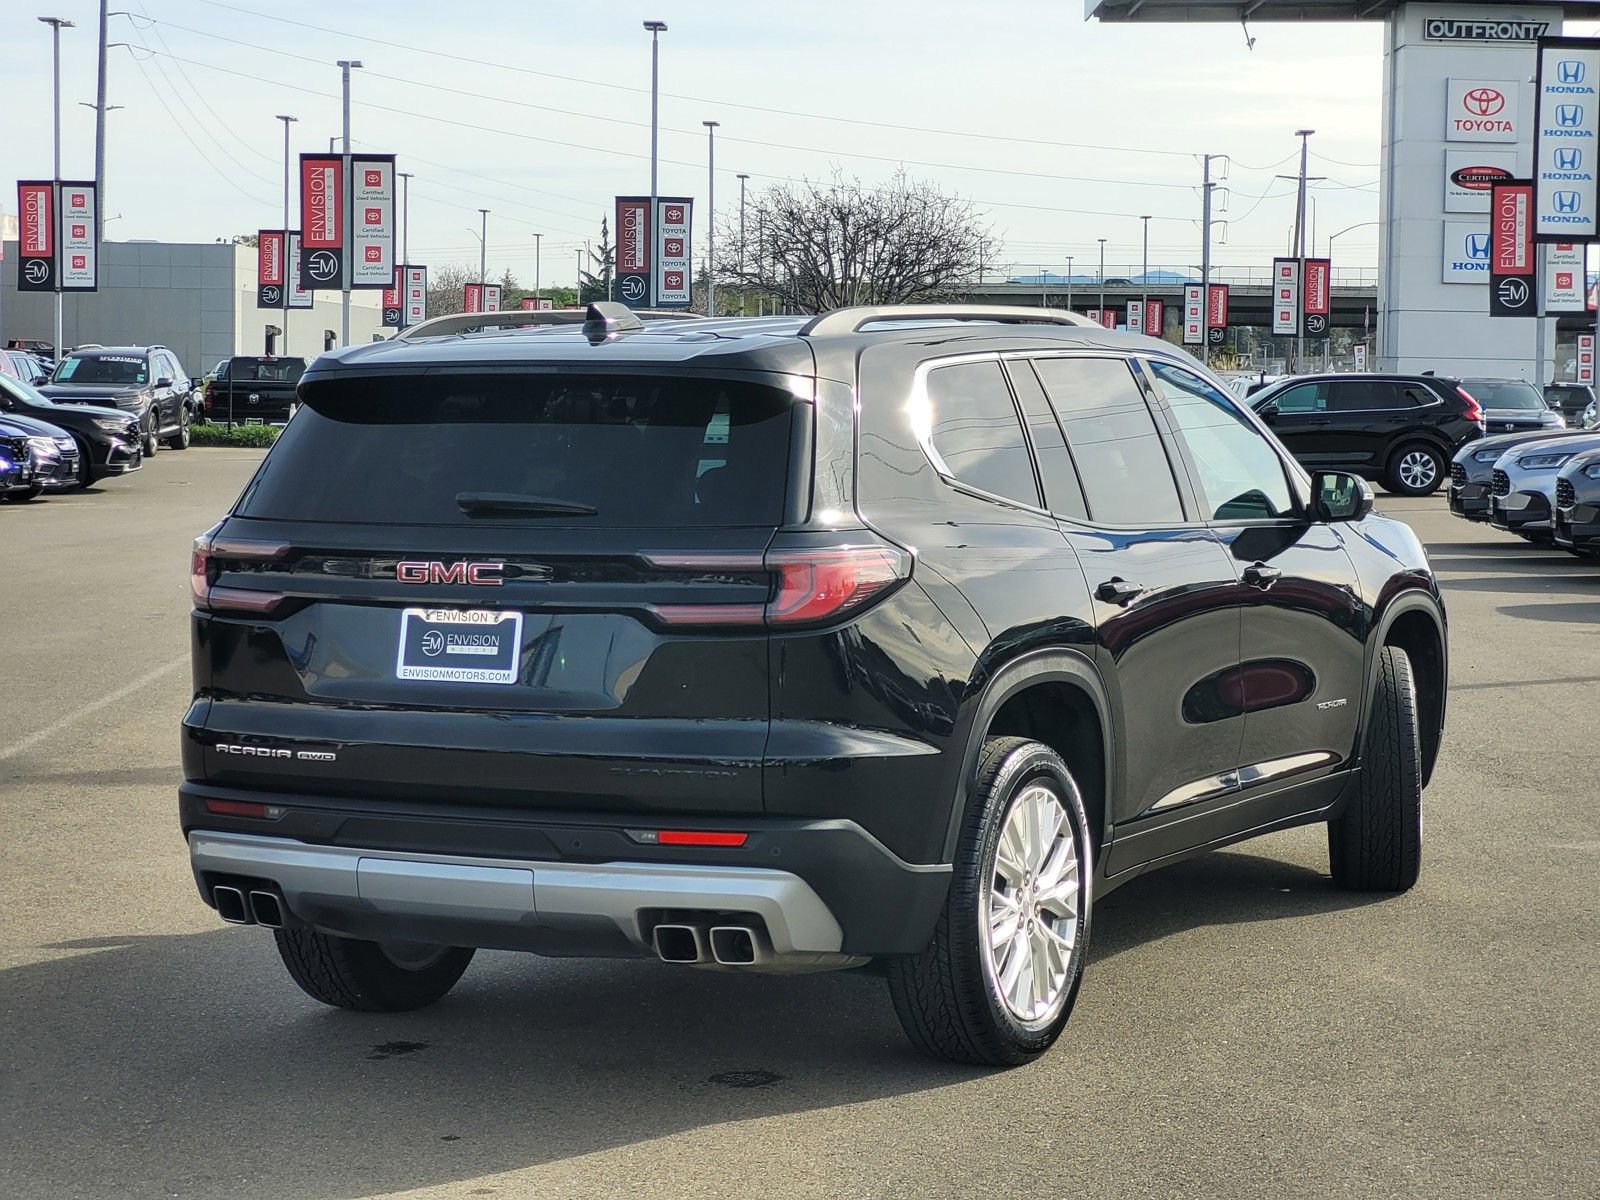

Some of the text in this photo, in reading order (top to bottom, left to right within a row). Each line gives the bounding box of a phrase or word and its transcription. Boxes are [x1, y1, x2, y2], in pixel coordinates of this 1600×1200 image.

[1454, 120, 1513, 132] TOYOTA
[311, 168, 324, 240] ENVISION
[26, 192, 37, 251] ENVISION
[625, 208, 635, 267] ENVISION
[1501, 193, 1515, 268] ENVISION
[264, 237, 272, 280] ENVISION
[1309, 266, 1318, 310] ENVISION
[396, 561, 503, 585] GMC
[436, 611, 488, 622] ENVISION
[447, 634, 500, 646] ENVISION
[402, 668, 510, 681] ENVISIONMOTORS.COM
[216, 744, 336, 761] ACADIA AWD
